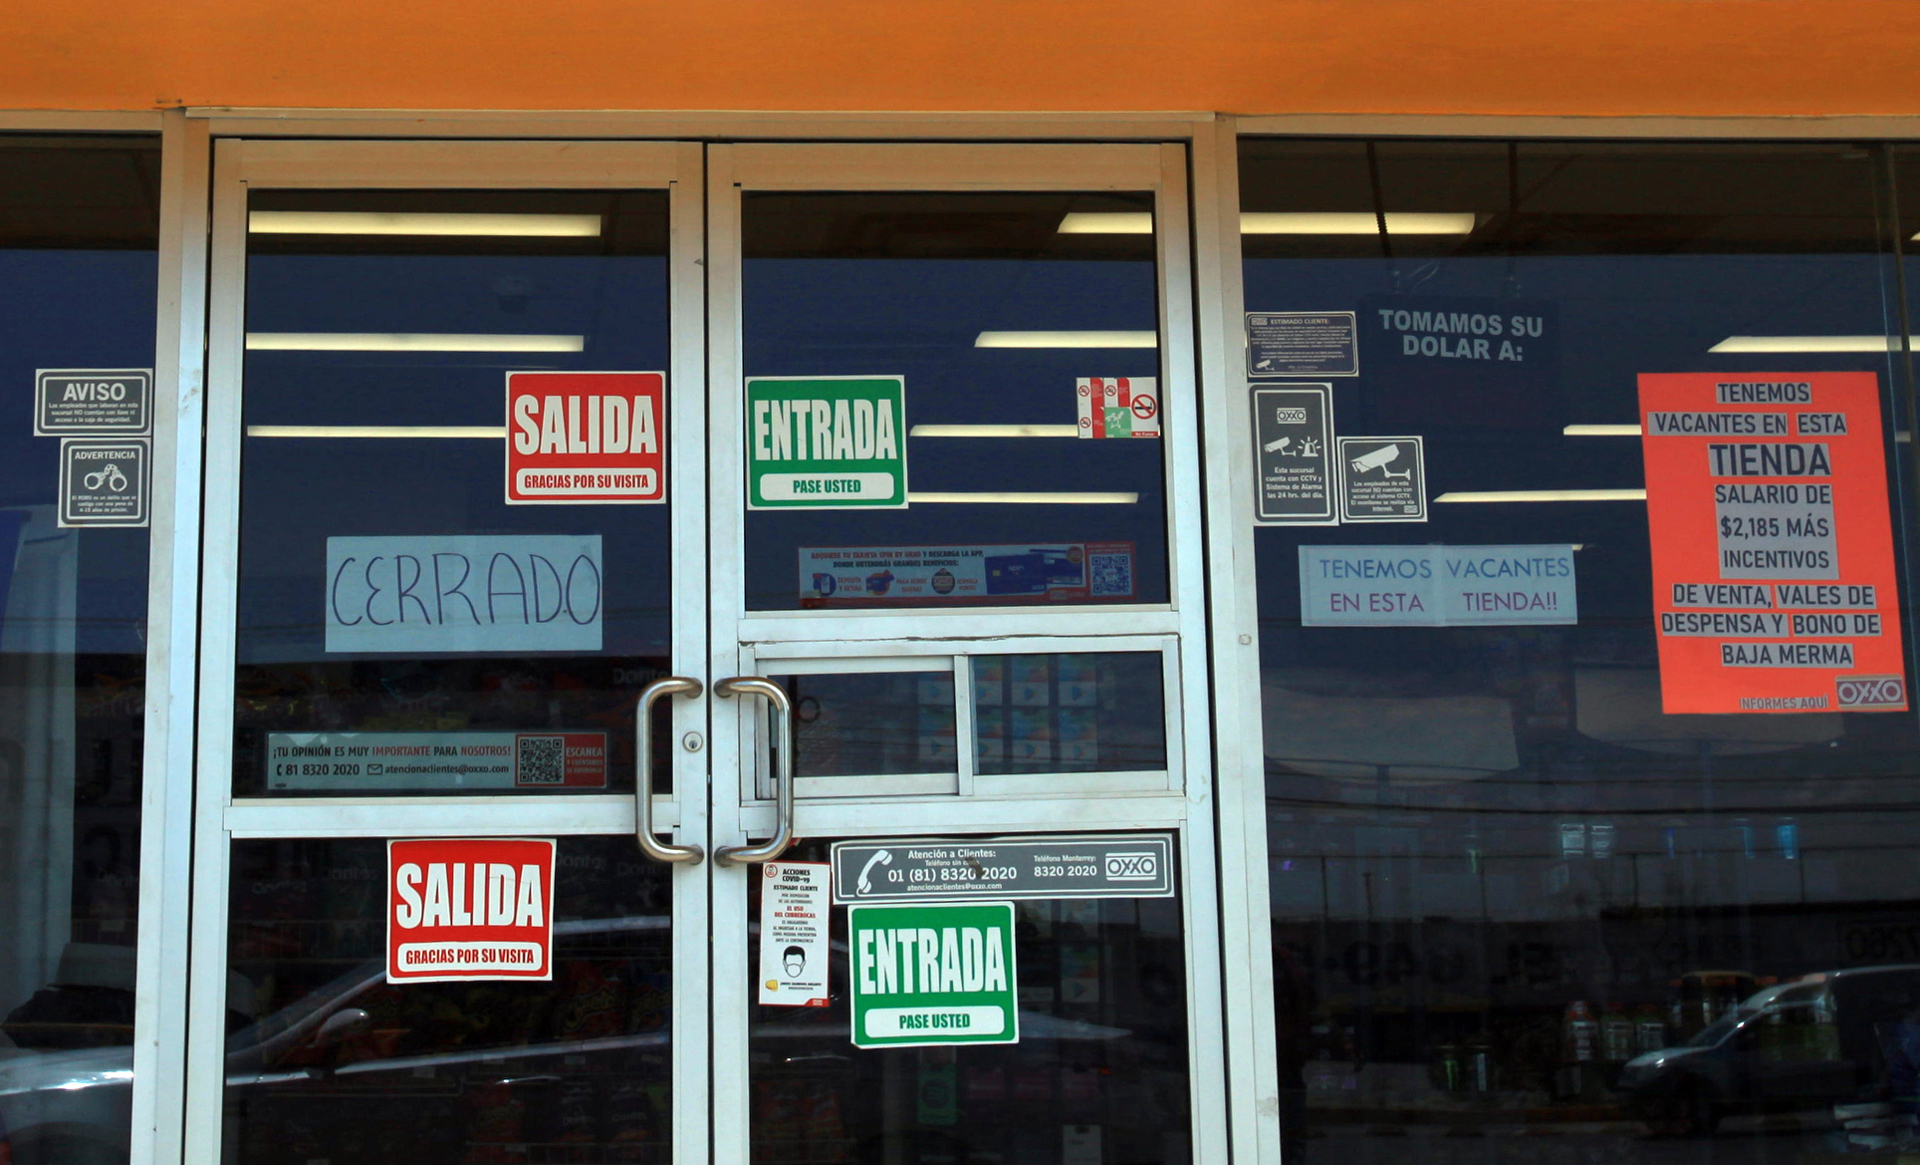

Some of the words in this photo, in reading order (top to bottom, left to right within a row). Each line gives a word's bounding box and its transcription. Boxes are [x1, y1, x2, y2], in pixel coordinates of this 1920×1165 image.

[1378, 309, 1503, 335] TOMAMOS
[1511, 316, 1543, 337] SU
[1403, 334, 1490, 360] DOLAR
[1498, 340, 1522, 361] A:
[63, 382, 126, 402] AVISO
[1718, 383, 1809, 402] TENEMOS
[515, 394, 657, 455] SALIDA
[1277, 409, 1306, 423] OXXO
[1654, 413, 1756, 433] VACANTES
[1763, 414, 1787, 434] EN
[1799, 414, 1846, 433] ESTA
[754, 399, 897, 460] ENTRADA
[75, 451, 136, 459] ADVERTENCIA
[1709, 444, 1831, 476] TIENDA
[524, 474, 571, 488] GRACIAS
[574, 474, 595, 488] POR
[597, 474, 611, 488] SU
[614, 474, 648, 488] VISITA
[793, 480, 822, 493] PASE
[824, 480, 861, 493] USTED
[1715, 484, 1798, 504] SALARIO
[1806, 484, 1831, 504] DE
[1721, 515, 1780, 540] $2,185
[1787, 513, 1829, 537] MÁS
[1320, 559, 1432, 579] TENEMOS
[1445, 557, 1570, 578] VACANTES
[1723, 550, 1829, 569] INCENTIVOS
[332, 552, 600, 626] CERRADO
[1673, 584, 1697, 604] DE
[1703, 584, 1772, 609] VENTA,
[1778, 585, 1841, 605] VALES
[1848, 586, 1874, 605] DE
[1330, 594, 1359, 612] EN
[1370, 593, 1424, 612] ESTA
[1462, 592, 1557, 611] TIENDA!!
[1662, 613, 1766, 633] DESPENSA
[1771, 614, 1782, 633] Y
[1792, 614, 1846, 634] BONO
[1854, 615, 1879, 634] DE
[1721, 645, 1772, 664] BAJA
[1779, 645, 1852, 664] MERMA
[1800, 693, 1828, 708] AQUÍ
[1839, 681, 1902, 705] OXXO
[273, 747, 288, 758] ¡TU
[292, 744, 331, 756] OPINIÓN
[334, 747, 344, 756] ES
[348, 747, 369, 756] MUY
[372, 746, 430, 756] IMPORTANTE
[434, 746, 457, 756] PARA
[461, 746, 511, 756] NOSOTROS!
[566, 748, 602, 756] ESCANEA
[286, 764, 298, 775] 81
[302, 764, 329, 775] 8320
[333, 764, 360, 775] 2020
[385, 764, 509, 775] atencionaclientes@oxxo.com
[908, 850, 947, 859] Atención
[958, 849, 996, 858] Clientes:
[888, 870, 903, 882] 01
[910, 869, 936, 882] (81)
[941, 868, 976, 880] 8320
[981, 867, 1017, 880] 2020
[1034, 866, 1064, 877] 8320
[1068, 865, 1097, 876] 2020
[1107, 857, 1155, 876] OXXO
[396, 863, 544, 929] SALIDA
[907, 883, 1002, 891] atencionaclientes@oxxo.com
[406, 949, 454, 964] GRACIAS
[457, 949, 478, 963] POR
[482, 949, 496, 963] SU
[499, 949, 534, 963] VISITA
[858, 927, 1007, 995] ENTRADA
[899, 1014, 929, 1029] PASE
[932, 1014, 970, 1028] USTED
